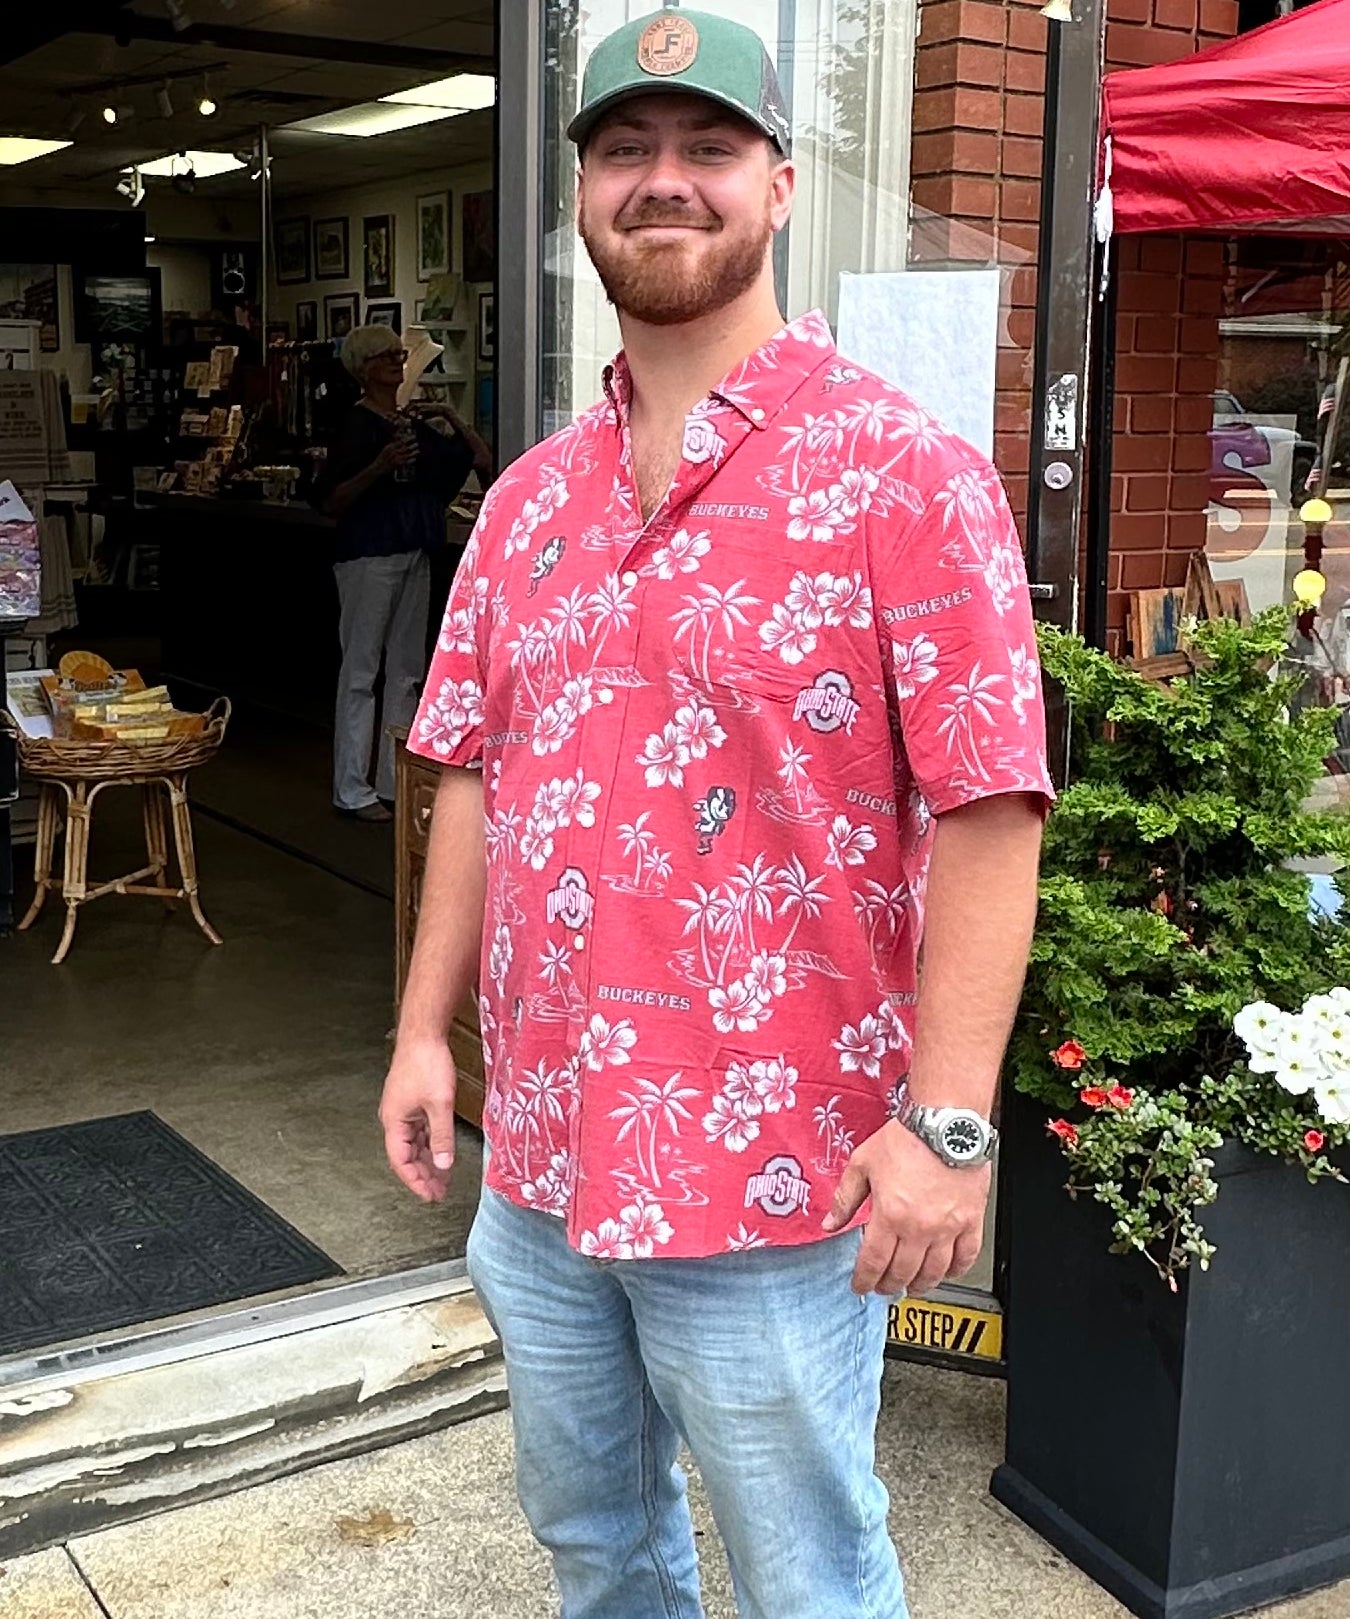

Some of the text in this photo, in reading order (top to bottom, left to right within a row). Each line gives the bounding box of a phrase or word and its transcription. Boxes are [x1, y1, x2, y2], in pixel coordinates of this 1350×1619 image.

[688, 503, 770, 520] BUCKEYES
[882, 586, 973, 625] BUCKEYES
[845, 787, 897, 816] BUCK
[597, 984, 691, 1011] BUCKEYES
[887, 1304, 954, 1348] R STEP
